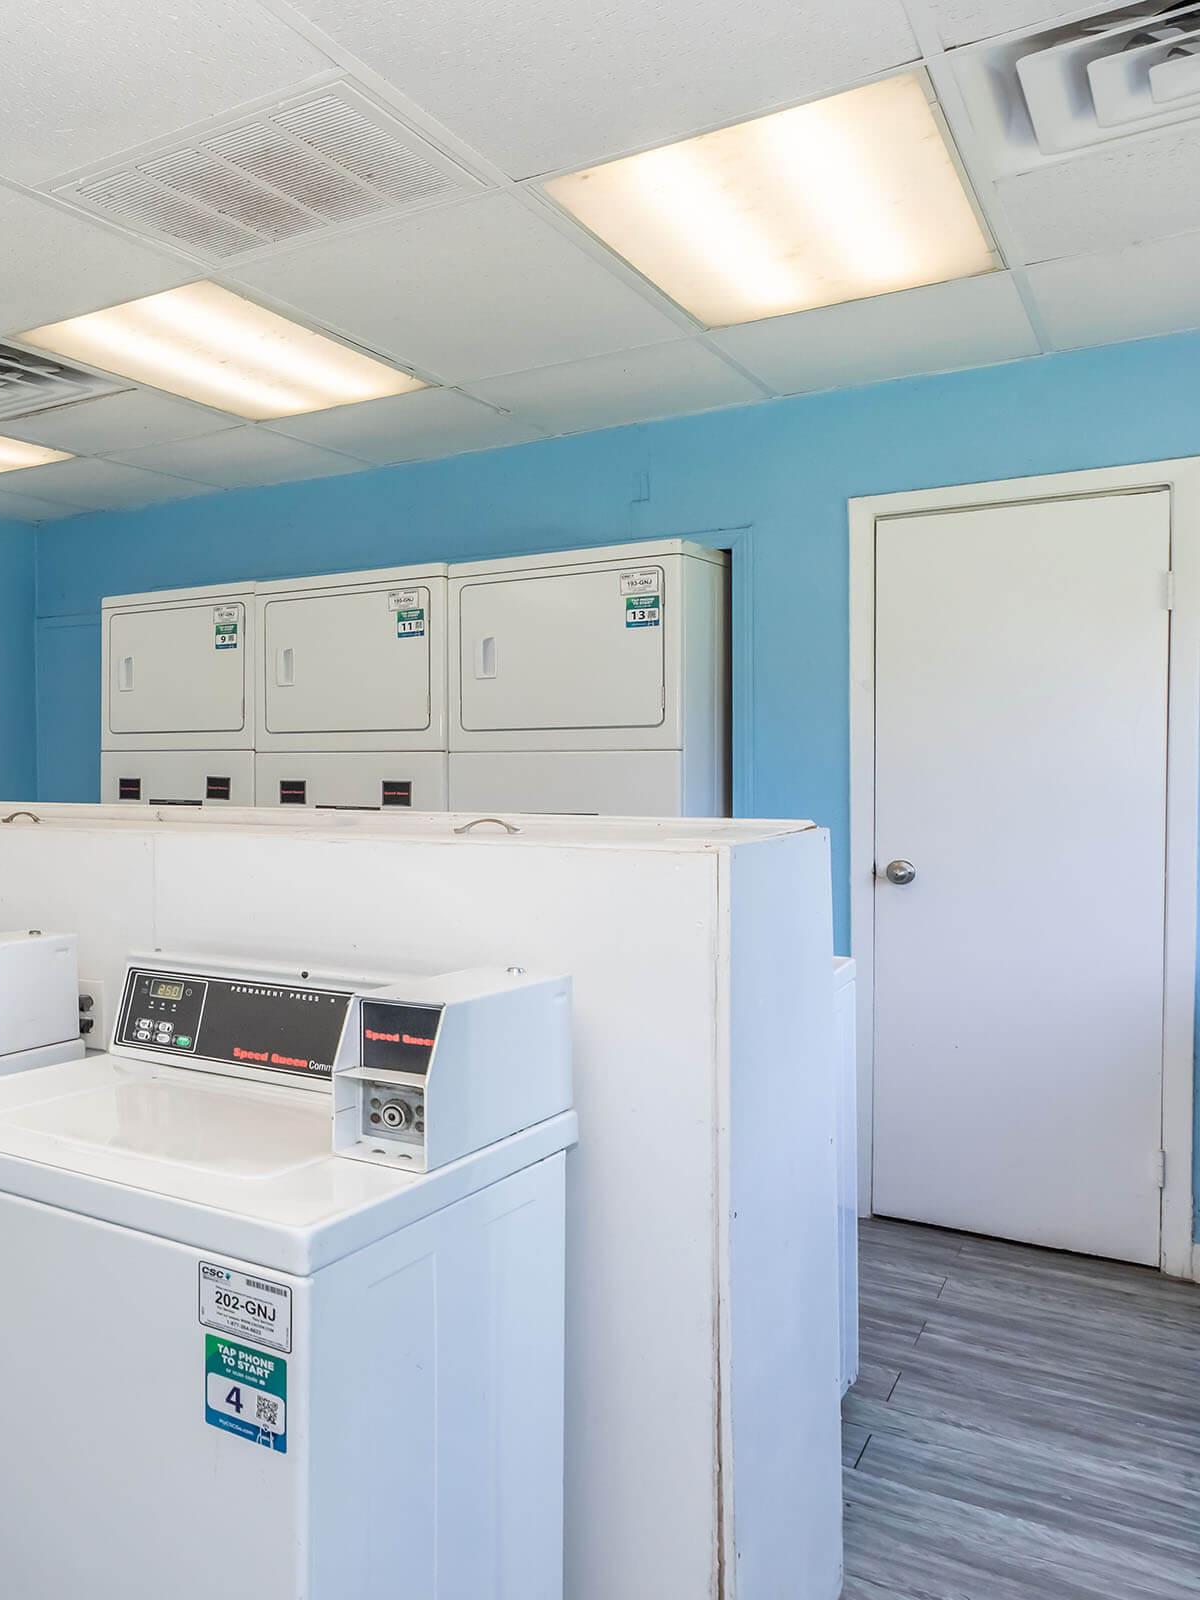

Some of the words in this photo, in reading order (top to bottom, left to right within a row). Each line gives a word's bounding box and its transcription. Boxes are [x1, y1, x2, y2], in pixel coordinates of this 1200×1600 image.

[631, 610, 646, 620] 13
[402, 622, 412, 631] 11
[220, 635, 226, 643] 9
[231, 986, 283, 997] PERMANENT
[290, 993, 319, 1003] PRESS
[365, 1029, 400, 1042] Speed
[233, 1047, 268, 1062] Speed
[271, 1053, 308, 1068] Queen
[202, 1266, 224, 1279] CSC
[215, 1290, 276, 1322] 202-GNJ
[217, 1343, 237, 1357] TAP
[238, 1351, 275, 1371] PHONE
[221, 1354, 235, 1367] TO
[237, 1360, 270, 1379] START
[225, 1386, 243, 1414] 4
